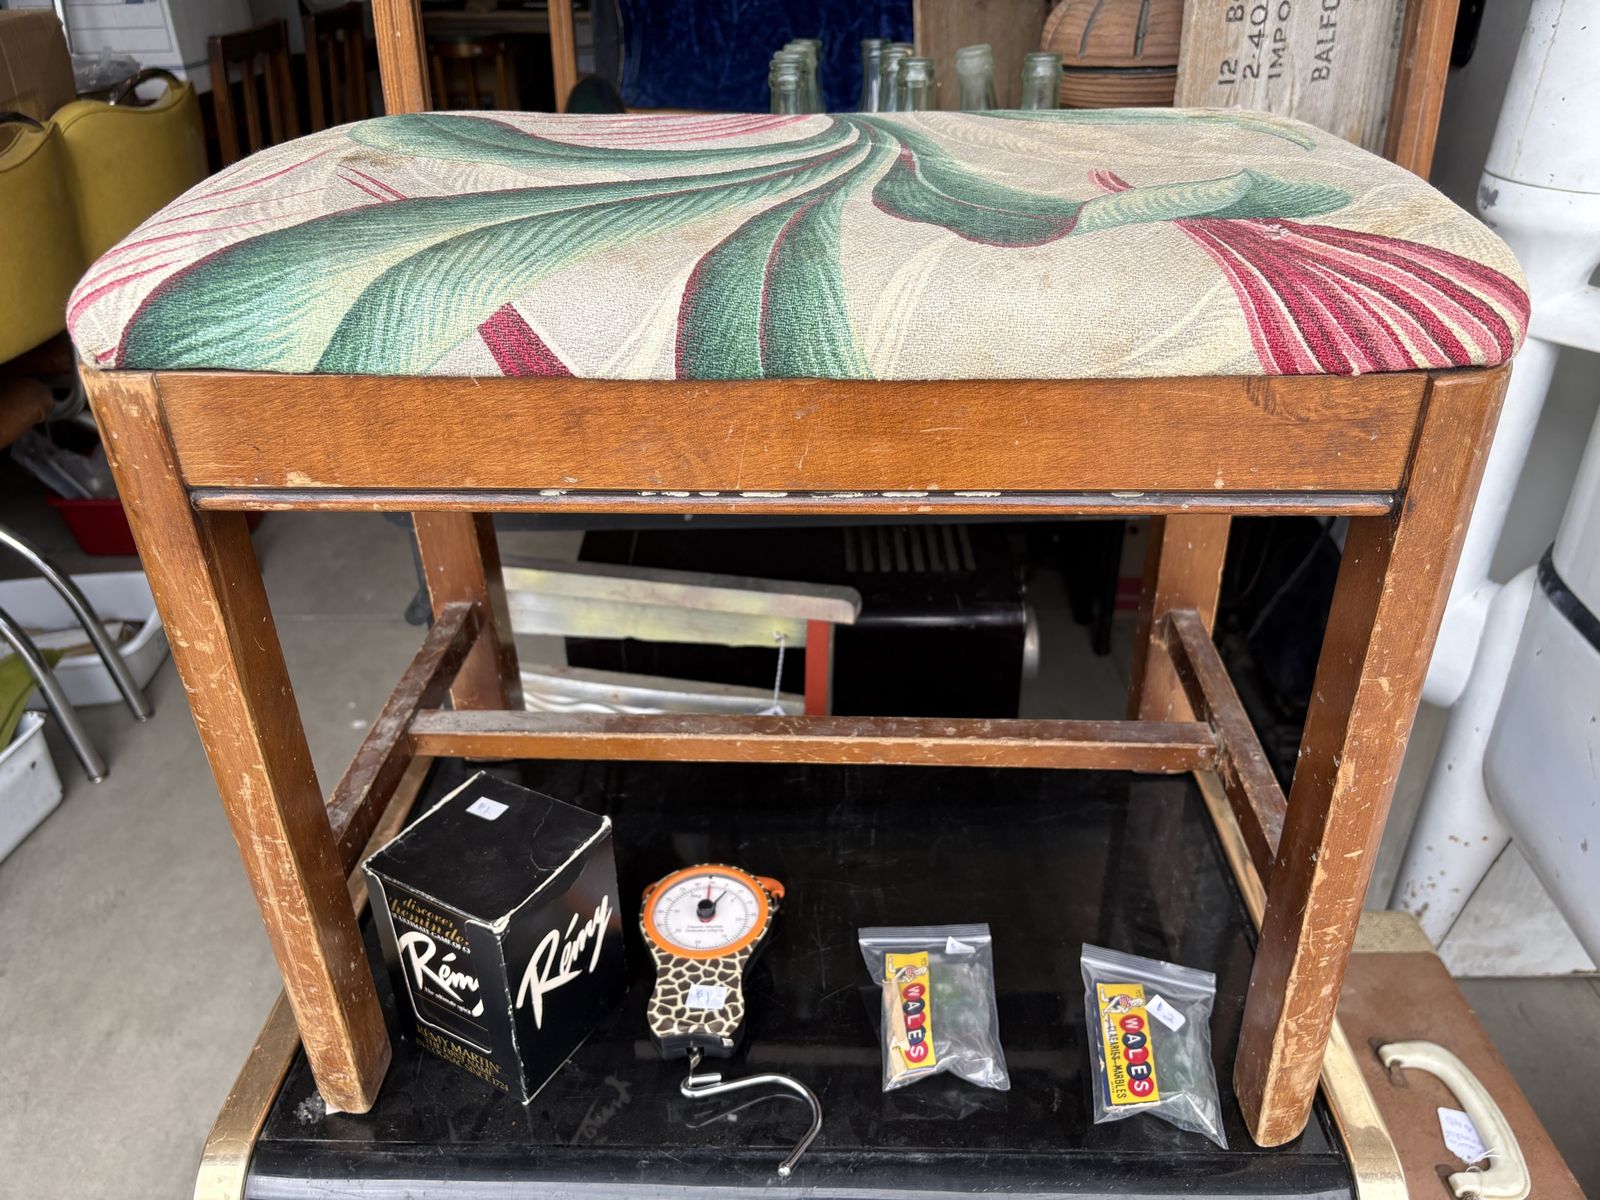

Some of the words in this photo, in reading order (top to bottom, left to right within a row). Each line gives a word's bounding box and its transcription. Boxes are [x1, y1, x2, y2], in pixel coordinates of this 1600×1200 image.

[1226, 0, 1244, 23] B
[1218, 59, 1238, 85] 12
[388, 898, 441, 933] hemin
[402, 898, 454, 928] discover
[516, 894, 612, 1030] Rémy
[907, 985, 924, 1057] WALES
[449, 1041, 501, 1073] MARTIN
[1125, 1017, 1149, 1091] WALES
